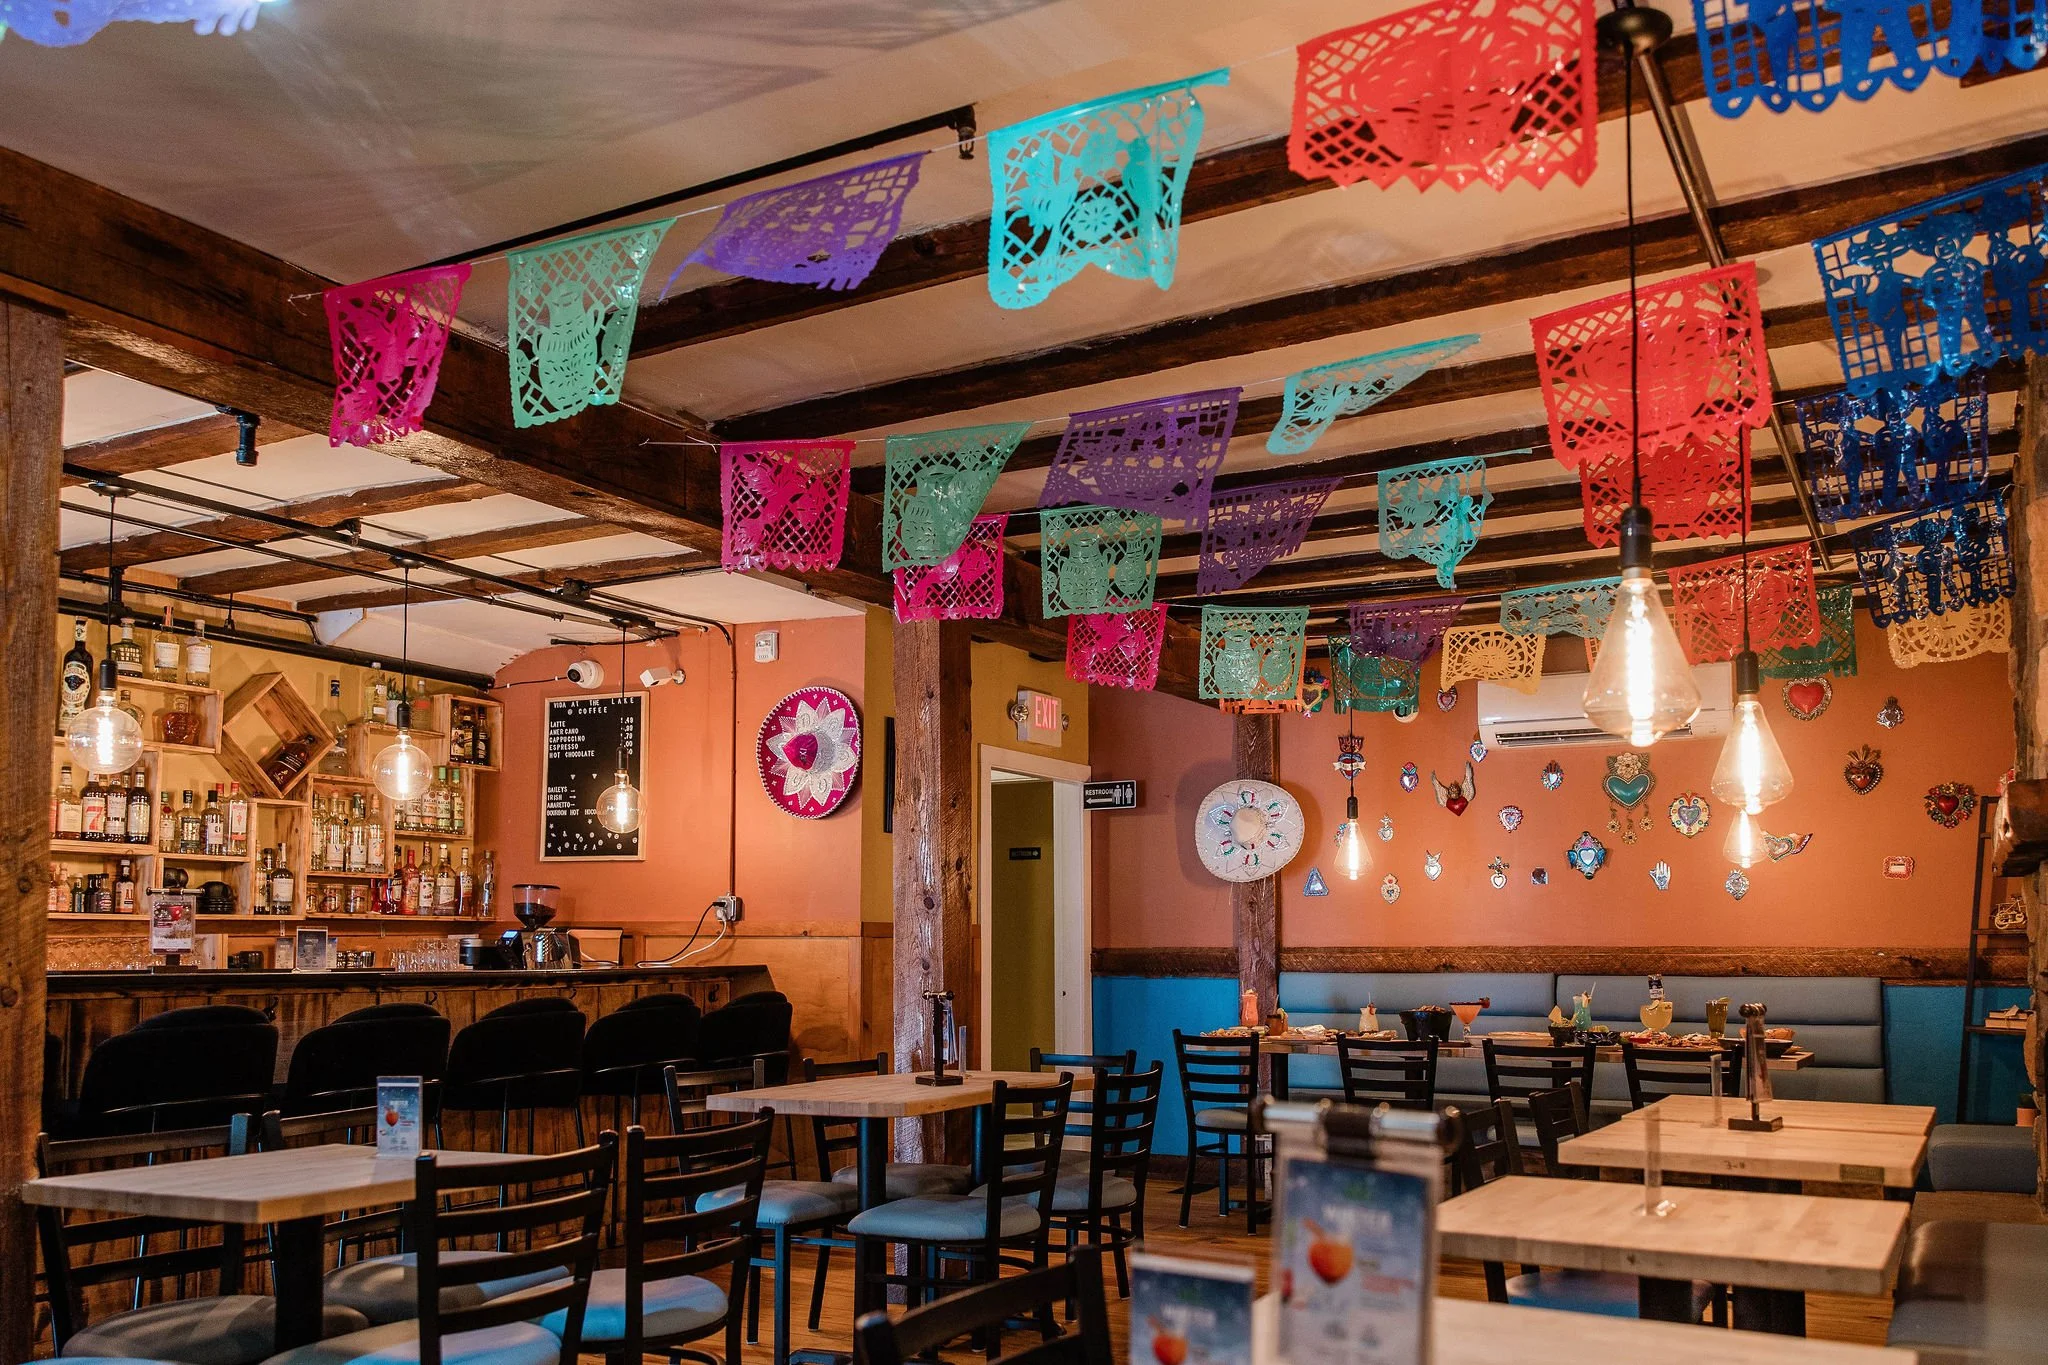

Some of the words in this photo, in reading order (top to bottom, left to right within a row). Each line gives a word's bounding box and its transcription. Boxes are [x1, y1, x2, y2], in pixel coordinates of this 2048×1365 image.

[571, 700, 579, 708] AT
[611, 697, 635, 705] LAKE
[578, 706, 608, 715] COFFEE
[1035, 696, 1059, 729] EXIT
[550, 720, 566, 728] LATTE
[549, 735, 586, 744] CAPPUCCINO
[549, 743, 579, 751] ESPRESSO
[549, 751, 561, 759] HOT
[564, 749, 595, 758] CHOCOLATE
[1085, 788, 1114, 796] RESTROOM
[546, 801, 571, 809] AMARETTO
[569, 808, 580, 816] HOT
